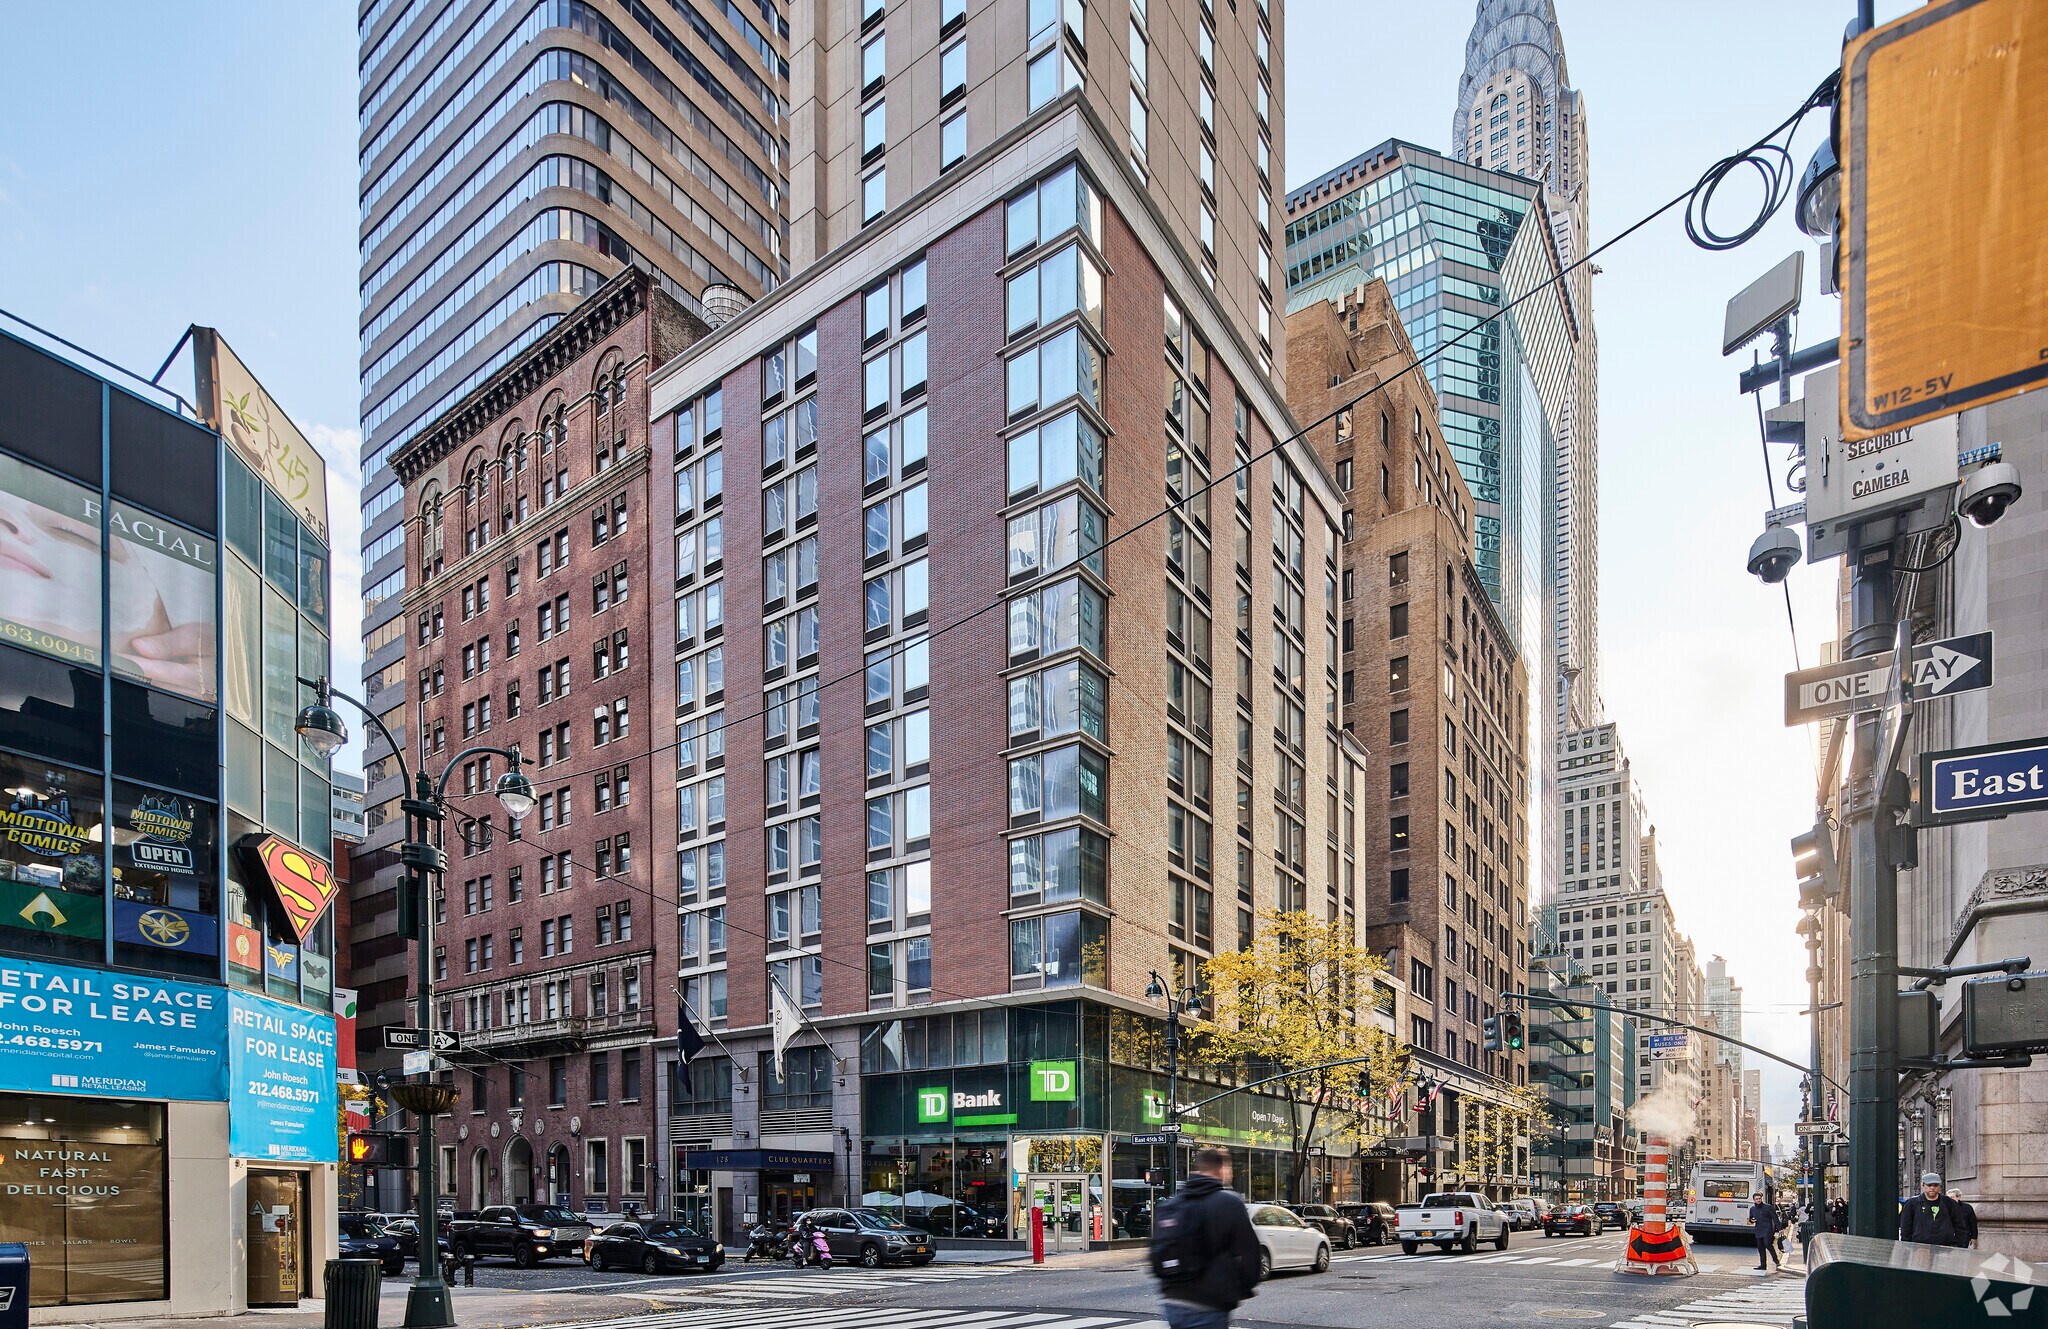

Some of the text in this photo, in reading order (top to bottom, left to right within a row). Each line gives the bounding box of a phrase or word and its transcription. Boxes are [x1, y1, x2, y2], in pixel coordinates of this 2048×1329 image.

[1874, 373, 1953, 411] W12-5V
[1848, 426, 1913, 459] SECURITY
[1959, 443, 2001, 466] NYPD
[277, 445, 309, 501] 45
[1852, 468, 1909, 497] CAMERA
[82, 498, 211, 565] FACIAL
[1814, 674, 1870, 703] ONE
[1951, 764, 2044, 800] East
[0, 811, 91, 840] MIDTOWN
[130, 808, 193, 831] MIDTOWN
[7, 828, 82, 855] COMICS
[138, 823, 186, 840] COMICS
[140, 846, 184, 865] OPEN
[134, 862, 195, 876] EXTENDED HOURS
[112, 983, 213, 1011] SPACE
[0, 991, 197, 1030] FOR LEASE
[33, 1024, 81, 1037] Roesch
[233, 1006, 333, 1048] RETAIL SPACE
[396, 1034, 418, 1043] ONE
[133, 1042, 217, 1056] James Famularo
[143, 1051, 207, 1062] @jamesfamularo
[246, 1036, 325, 1069] FOR LEASE
[81, 1075, 146, 1088] MERIDIAN
[81, 1082, 146, 1093] RETAIL LEASING
[262, 1068, 308, 1085] John Roesch
[1037, 1070, 1070, 1092] TD
[248, 1080, 319, 1103] 212.468.5971
[921, 1089, 1001, 1117] TD Bank
[1252, 1110, 1285, 1124] Open 7 Days
[15, 1149, 112, 1162] NATURAL
[768, 1155, 832, 1165] CLUB QUARTERS
[40, 1168, 89, 1178] FAST
[7, 1184, 120, 1196] DELICIOUS
